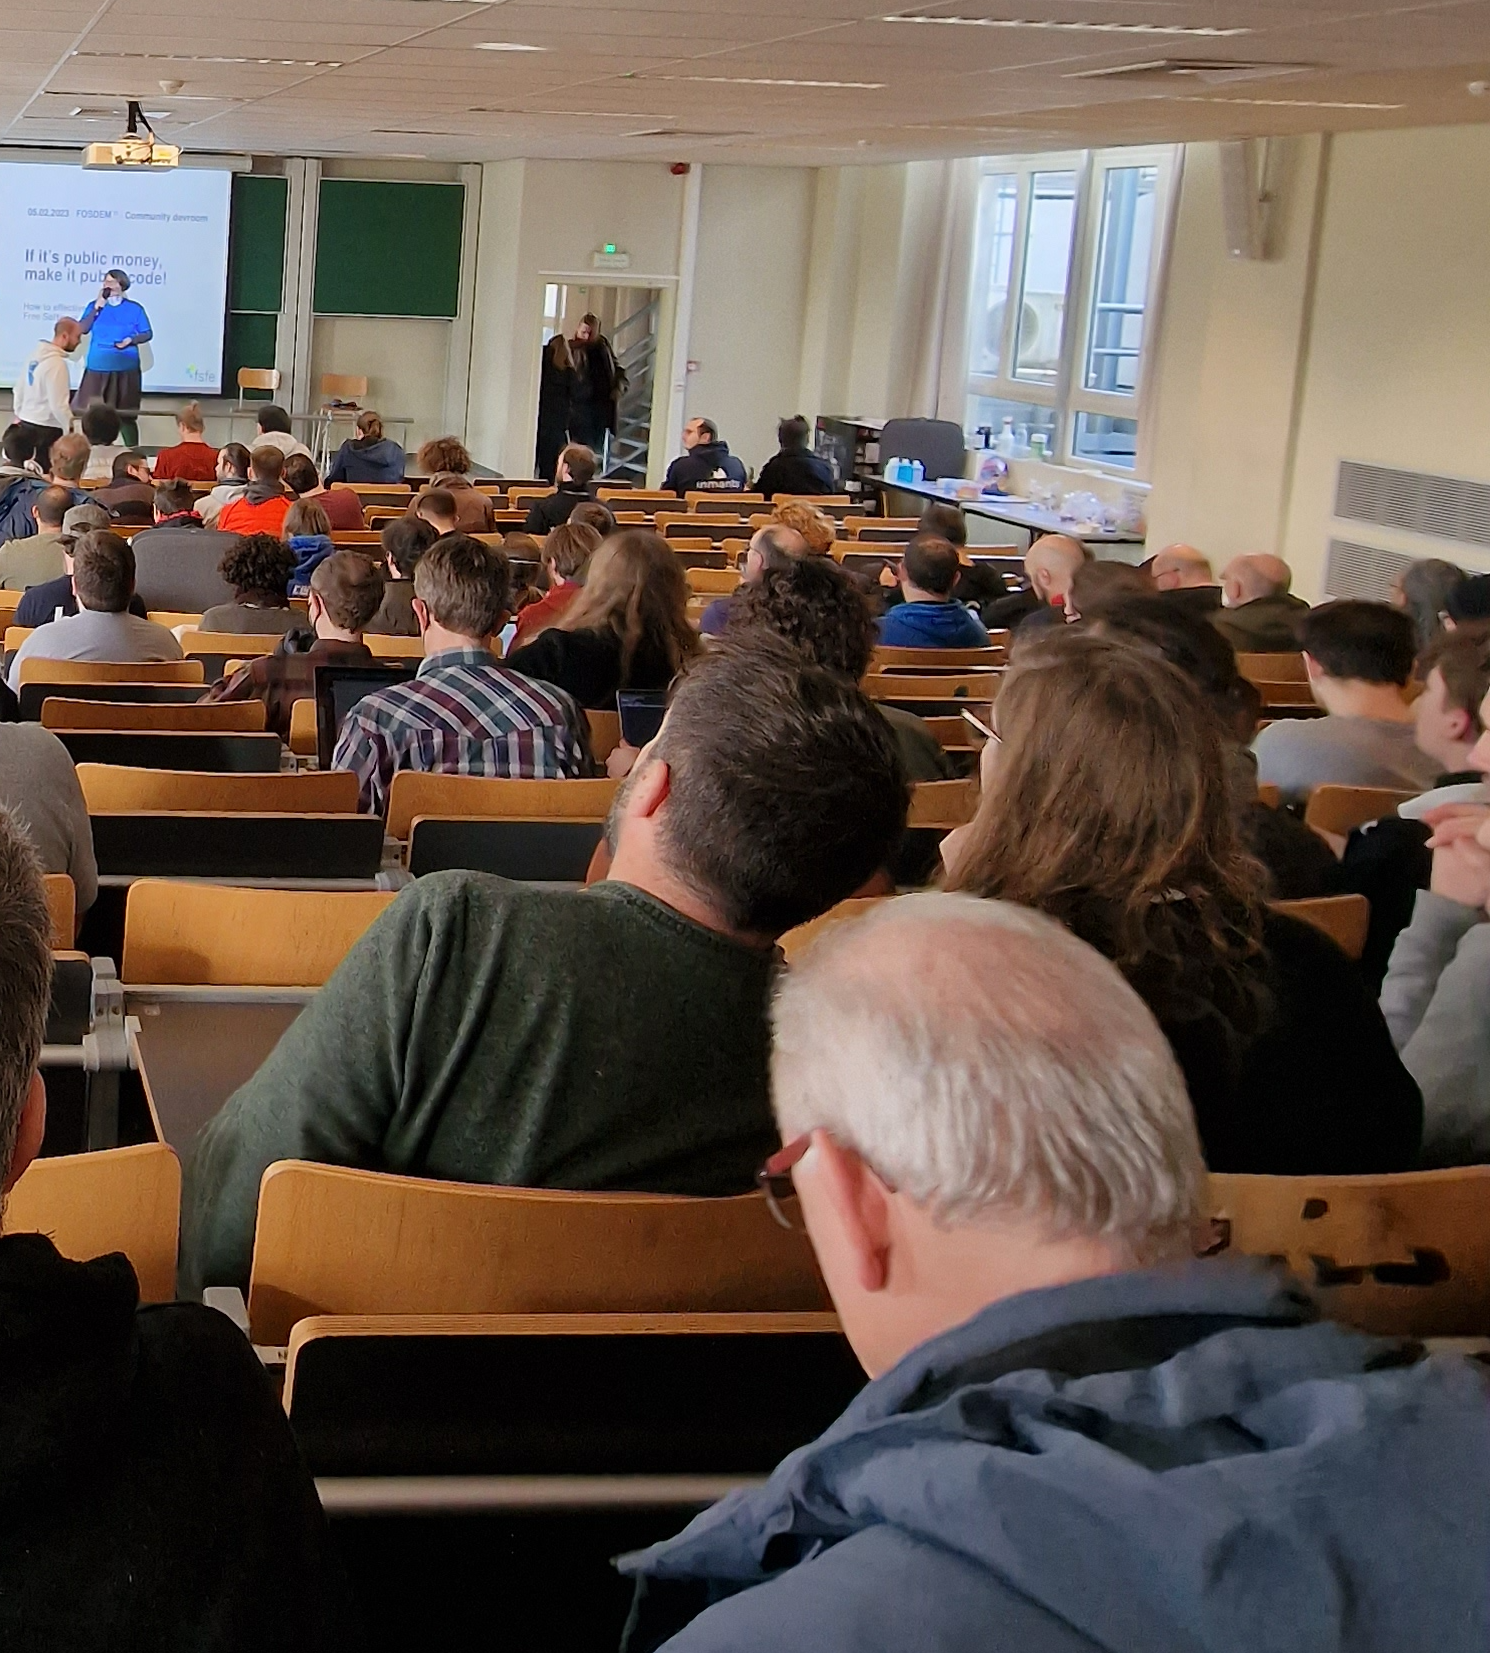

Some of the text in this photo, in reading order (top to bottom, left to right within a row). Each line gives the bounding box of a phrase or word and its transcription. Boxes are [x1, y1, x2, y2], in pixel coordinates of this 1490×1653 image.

[28, 208, 70, 217] 05.02.2023
[76, 209, 112, 219] FOSDEM
[125, 211, 170, 222] Community
[173, 213, 208, 222] devroom
[25, 249, 163, 270] If it's public money,
[25, 268, 63, 282] make
[66, 269, 76, 283] it
[129, 272, 167, 285] code!
[23, 303, 42, 311] How
[23, 312, 41, 320] Free
[195, 369, 215, 383] fsfe
